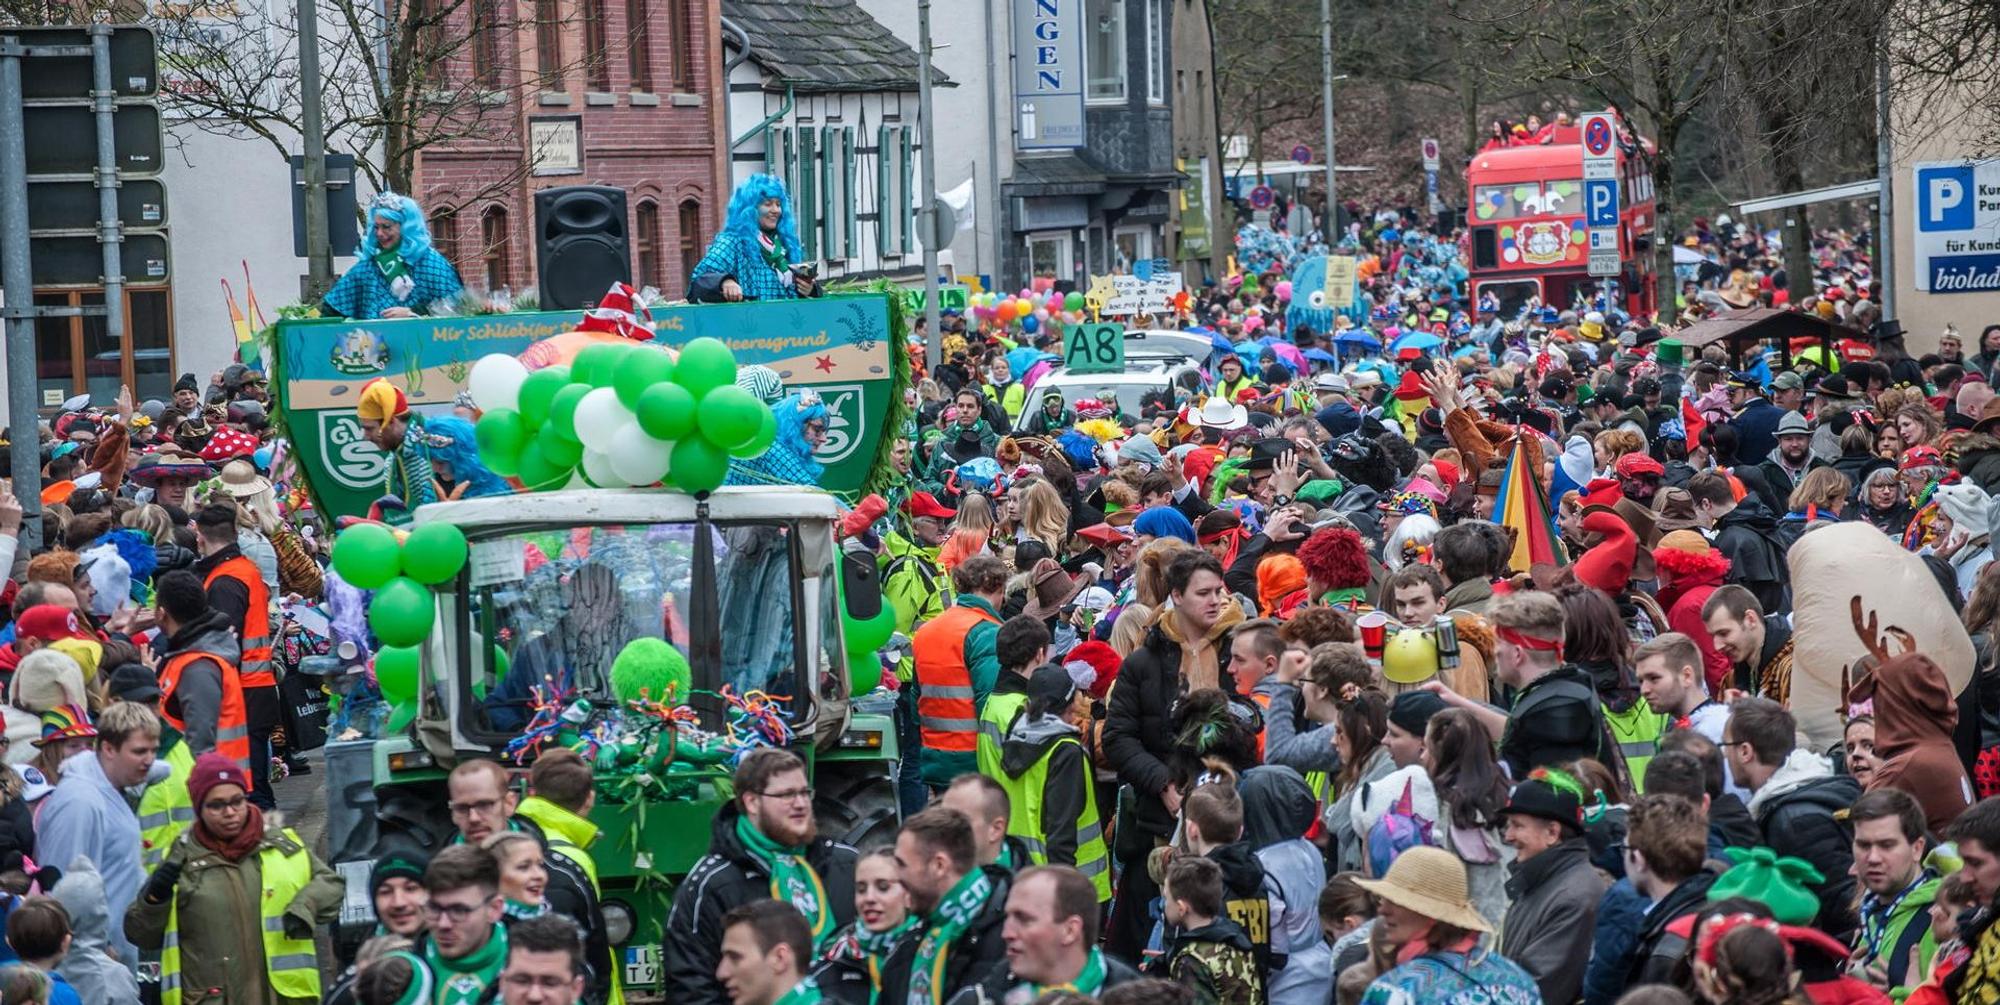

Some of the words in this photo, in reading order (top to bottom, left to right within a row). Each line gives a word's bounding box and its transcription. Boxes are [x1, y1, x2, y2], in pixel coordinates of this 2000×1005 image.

[1592, 185, 1611, 221] P
[1930, 178, 1963, 221] P
[1946, 240, 1965, 252] für
[433, 327, 463, 342] Mir
[1067, 326, 1117, 365] A8
[1226, 899, 1268, 944] FBI
